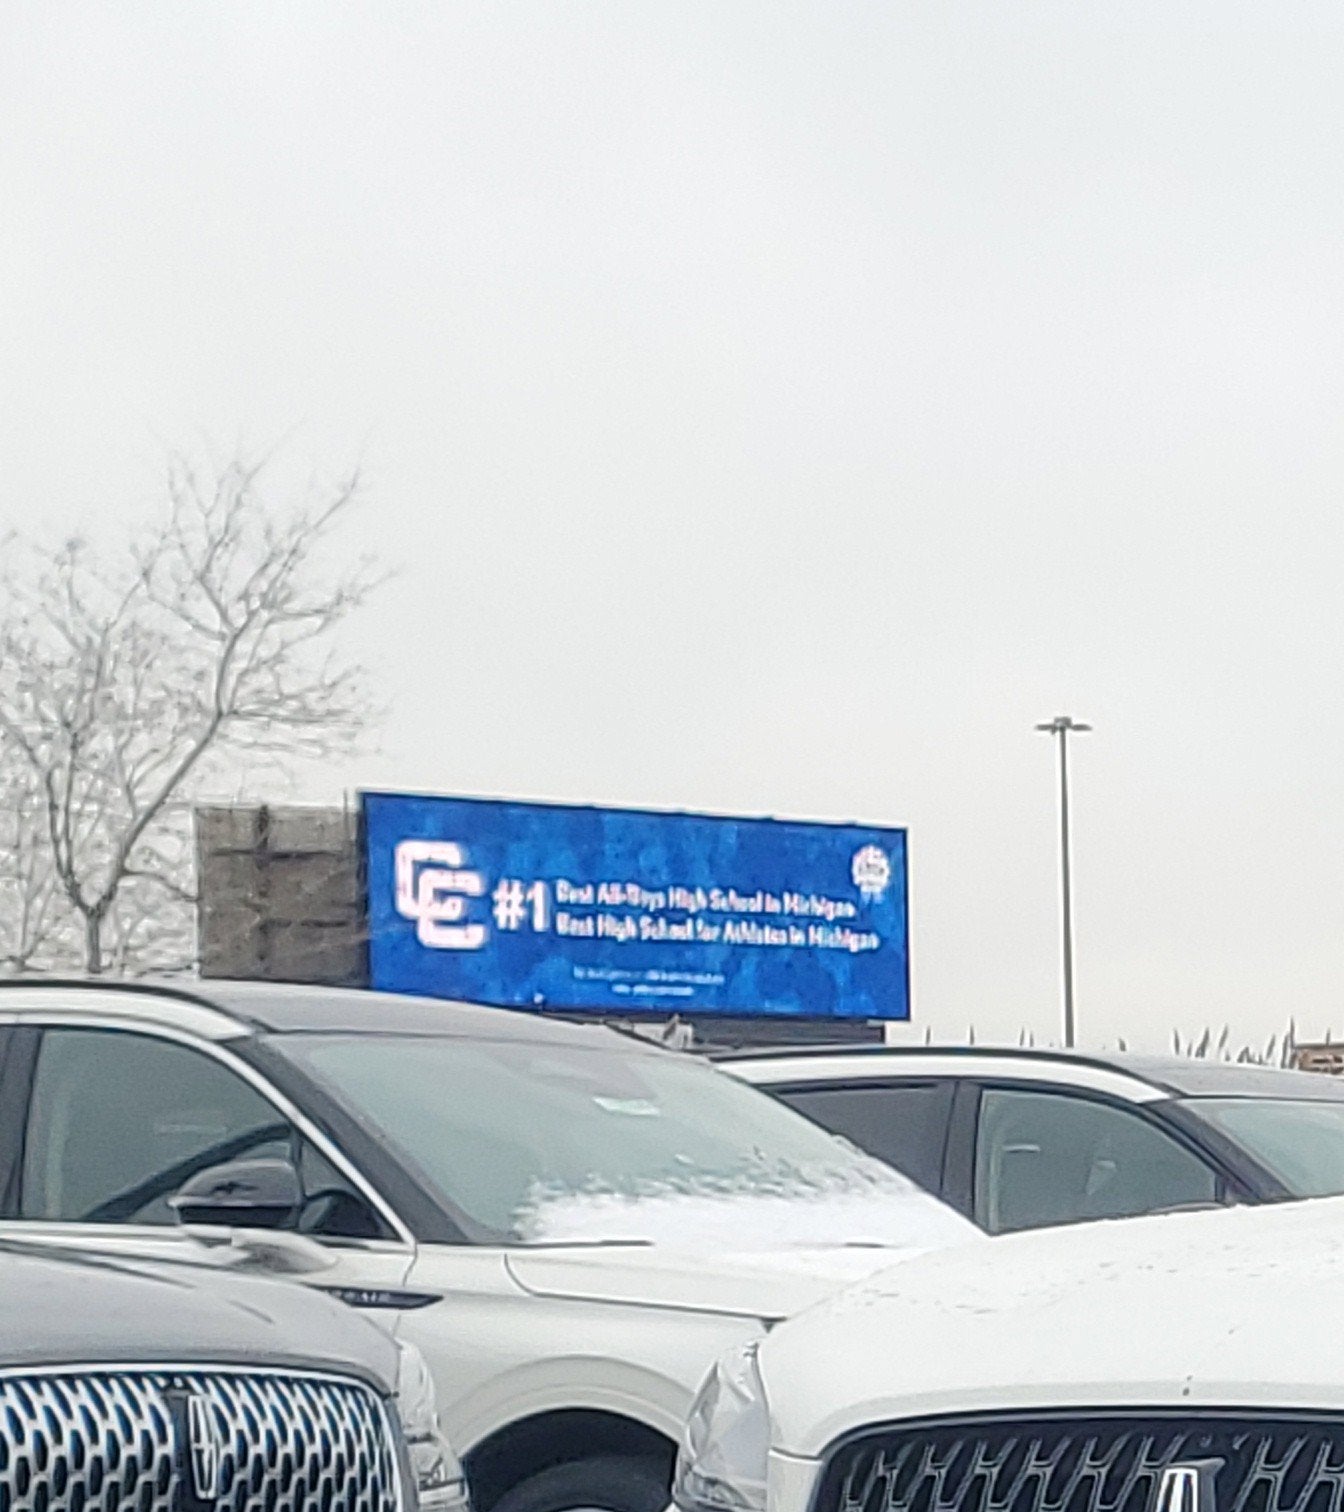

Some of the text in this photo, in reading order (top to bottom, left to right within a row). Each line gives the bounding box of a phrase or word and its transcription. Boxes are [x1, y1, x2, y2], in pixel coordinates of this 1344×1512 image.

[492, 880, 548, 933] #1
[783, 891, 856, 921] Michigan
[598, 913, 638, 942] High
[808, 923, 880, 952] Michigan
